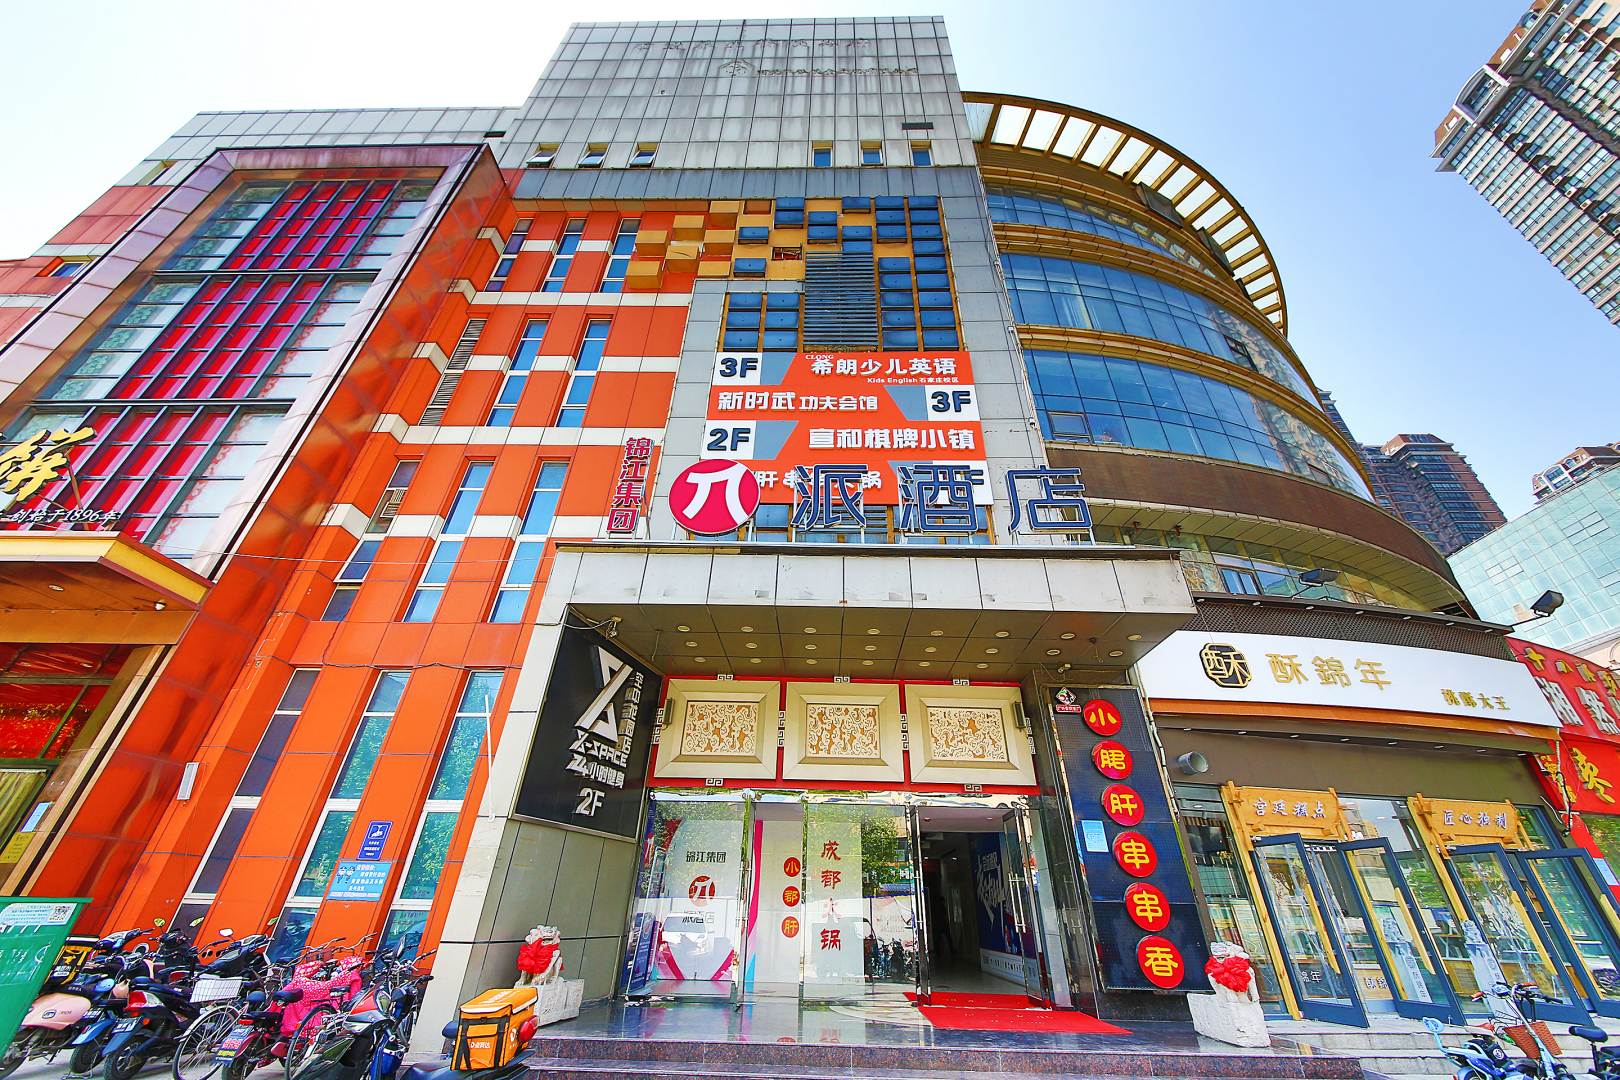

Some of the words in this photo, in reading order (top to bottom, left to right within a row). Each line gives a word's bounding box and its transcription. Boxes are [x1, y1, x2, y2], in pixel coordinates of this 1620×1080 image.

[719, 357, 758, 378] 3F
[811, 357, 956, 376] 希朗少儿英语
[867, 377, 885, 385] Kids
[888, 377, 917, 386] English
[931, 390, 972, 412] 3F
[707, 428, 751, 451] 2F
[808, 427, 976, 450] 宣和棋牌小镇
[607, 437, 651, 533] 锦江集团
[1199, 643, 1252, 688] 酥
[565, 753, 625, 789] 24小时健身
[576, 787, 605, 817] 2F
[686, 851, 726, 863] 锦江集团
